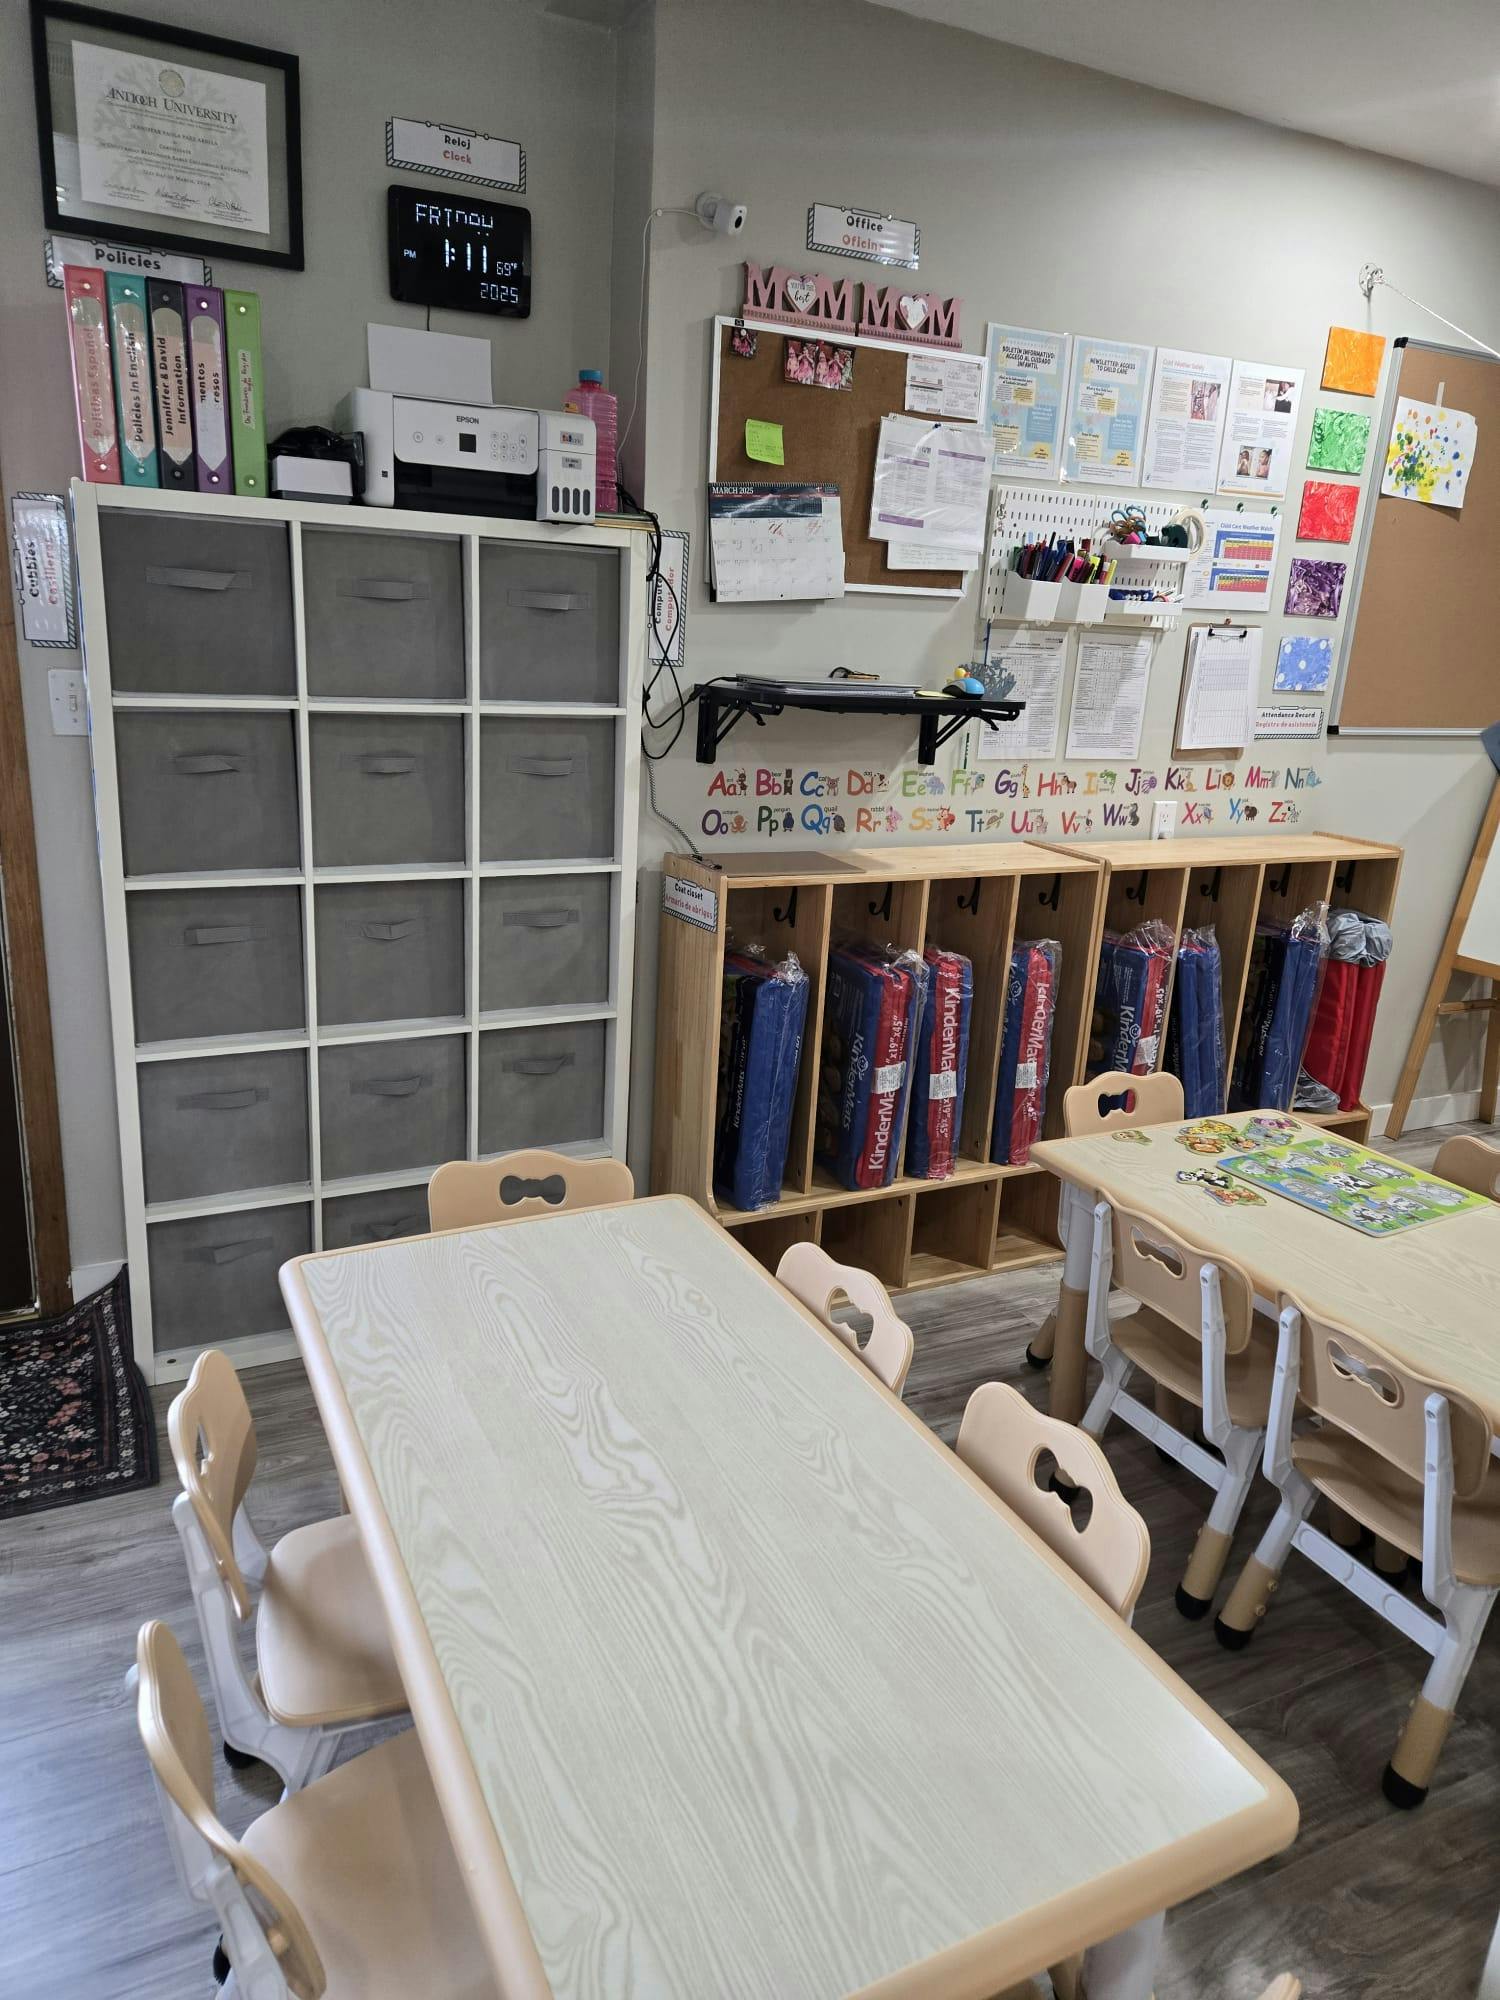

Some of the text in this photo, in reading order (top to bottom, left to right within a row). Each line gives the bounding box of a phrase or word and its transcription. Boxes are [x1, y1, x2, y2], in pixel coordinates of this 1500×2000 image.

[106, 87, 157, 108] ANTIOCH
[163, 98, 237, 125] UNIVERSITY
[444, 134, 471, 150] Reloj
[443, 150, 472, 164] Clock
[846, 215, 883, 232] Office
[95, 248, 161, 270] Policies
[403, 249, 417, 259] PM
[445, 238, 488, 274] 1:11
[480, 282, 519, 304] 2025
[794, 290, 811, 304] best
[130, 381, 140, 394] in
[157, 337, 175, 436] Jenniffer & David
[174, 355, 187, 425] Information
[132, 395, 144, 443] Policies
[456, 415, 480, 425] EPSON
[712, 486, 754, 495] MARCH 2025
[25, 541, 39, 597] Cubbies
[654, 575, 664, 624] Compute
[665, 566, 675, 631] Computdor
[824, 805, 838, 813] quail
[675, 883, 703, 900] Coat closet
[665, 895, 713, 919] Armario de abrigos
[940, 986, 961, 1072] KinderMa
[1114, 1005, 1136, 1073] KinderM
[869, 1090, 896, 1170] KinderMa
